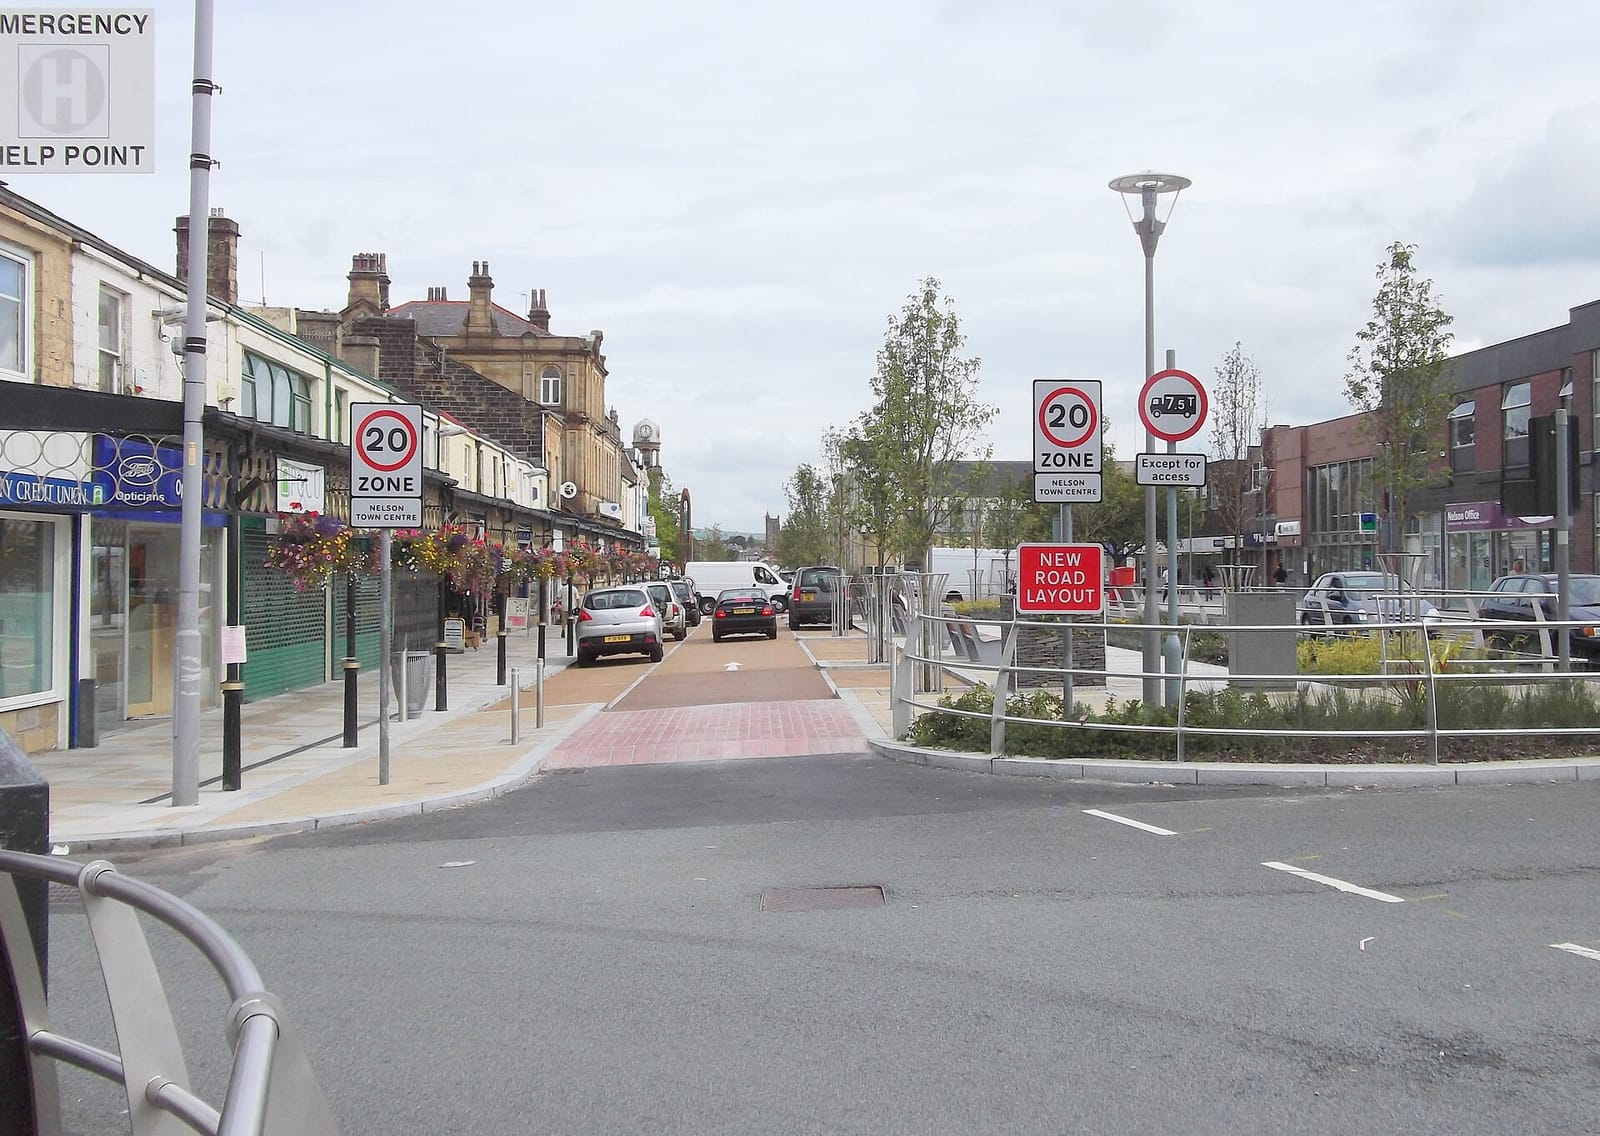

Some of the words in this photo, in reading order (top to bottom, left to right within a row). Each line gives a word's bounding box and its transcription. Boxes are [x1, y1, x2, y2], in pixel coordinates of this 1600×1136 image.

[65, 145, 145, 166] POINT
[1048, 403, 1088, 428] 20
[366, 427, 408, 453] 20
[1041, 453, 1094, 468] ZONE
[1142, 459, 1181, 471] Except
[1185, 458, 1201, 469] for
[358, 476, 414, 492] ZONE
[1052, 479, 1085, 487] NELSON
[1152, 473, 1190, 482] access
[16, 480, 54, 502] CREDIT
[57, 485, 87, 505] UNION
[115, 491, 165, 503] Opticians
[1040, 488, 1063, 496] TOWN
[1065, 488, 1097, 496] CENTRE
[369, 504, 404, 512] NELSON
[1447, 511, 1464, 521] Nelson
[1464, 509, 1480, 520] Office
[356, 513, 381, 521] TOWN
[383, 513, 417, 521] CENTRE
[1040, 552, 1081, 567] NEW
[1035, 570, 1086, 585] ROAD
[1026, 588, 1096, 603] LAYOUT
